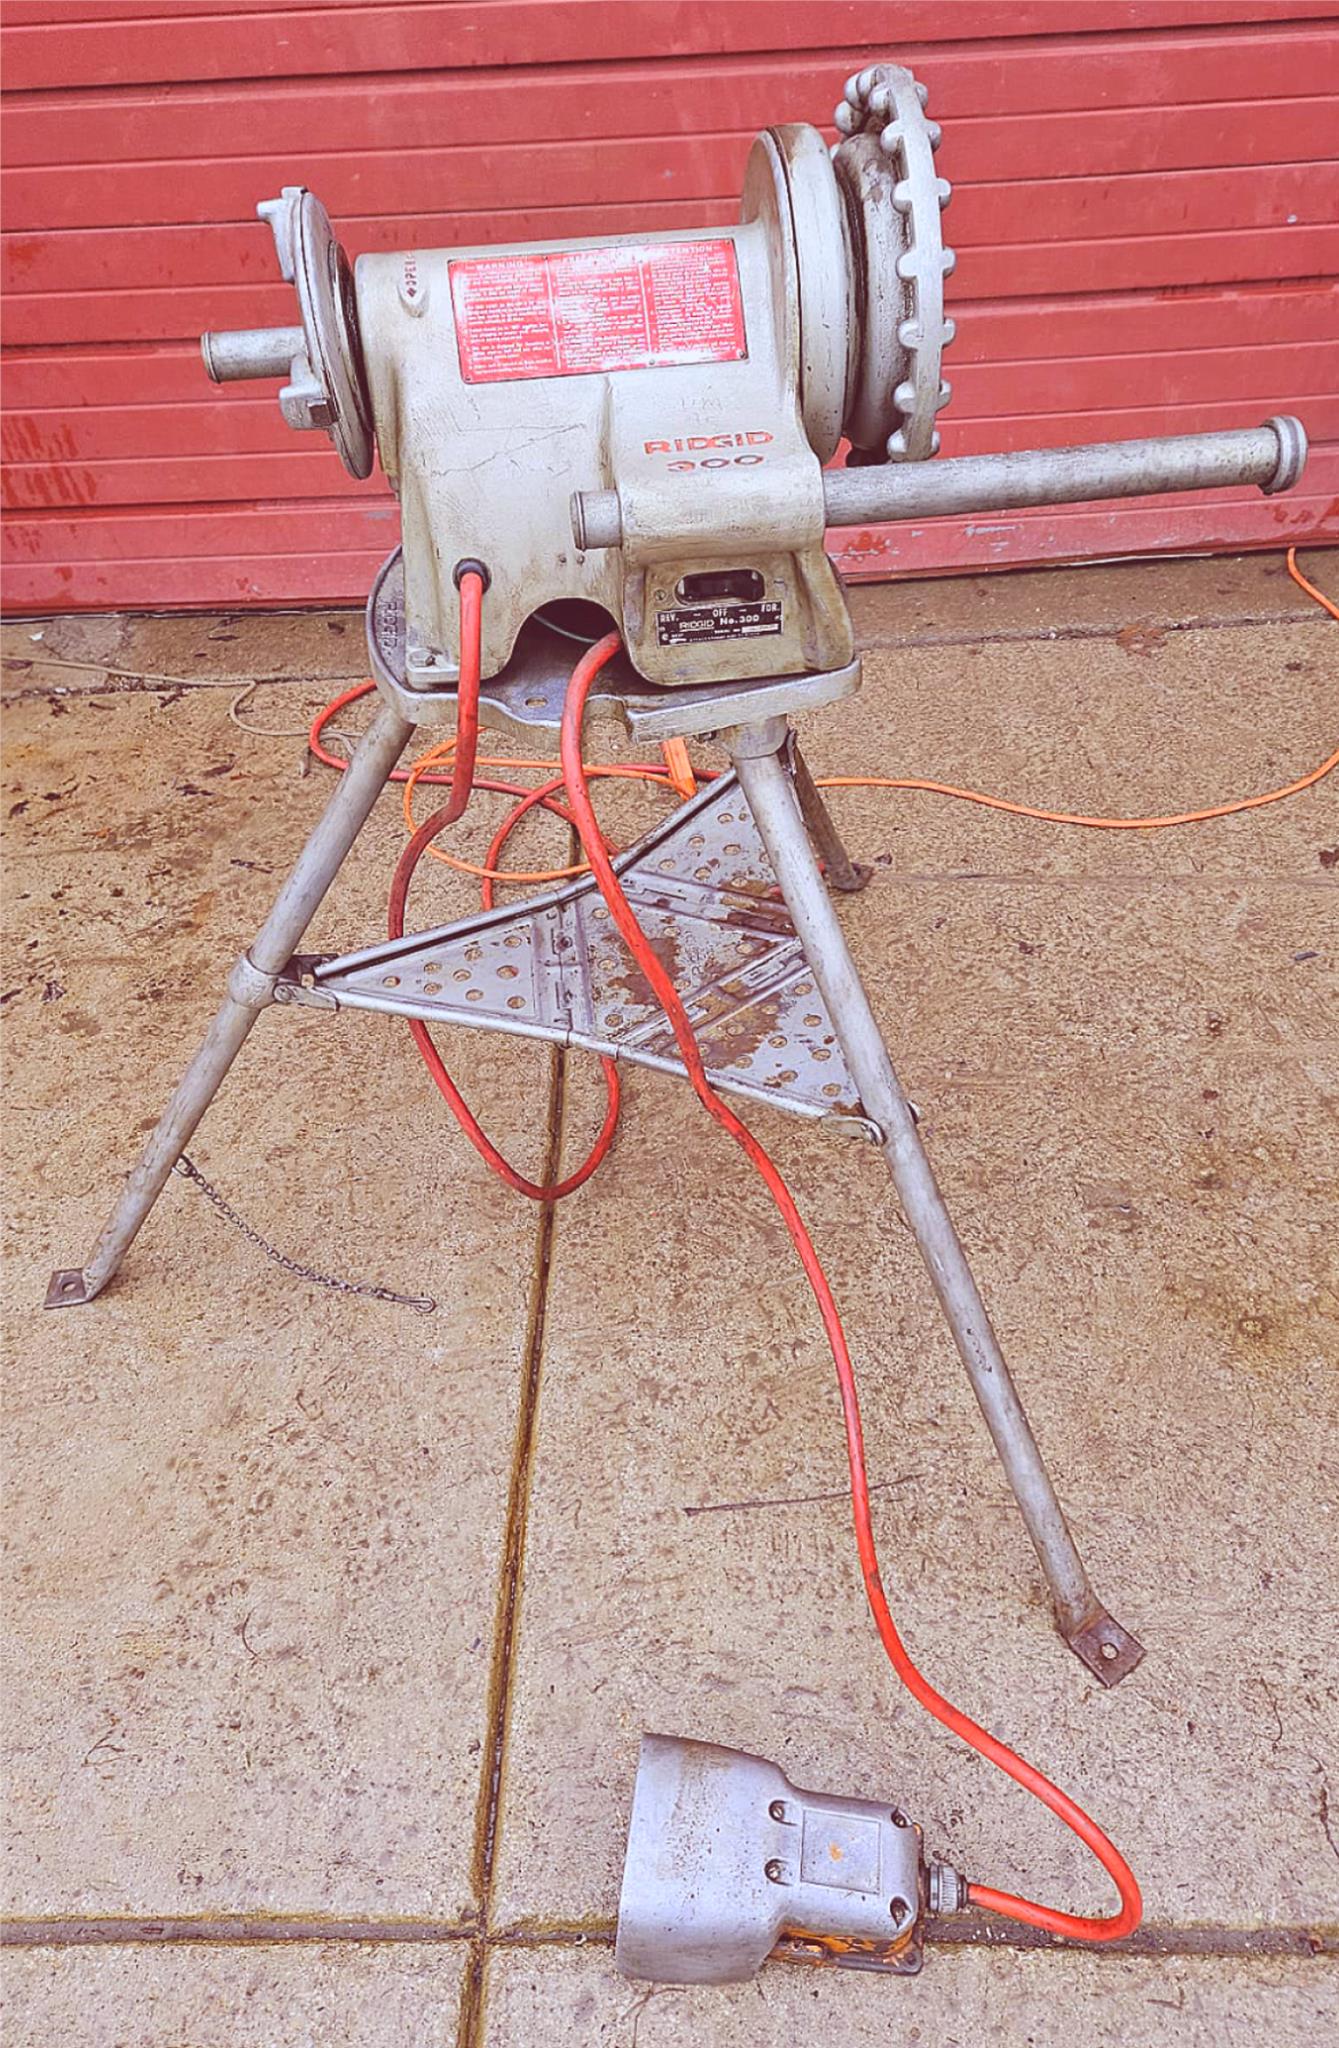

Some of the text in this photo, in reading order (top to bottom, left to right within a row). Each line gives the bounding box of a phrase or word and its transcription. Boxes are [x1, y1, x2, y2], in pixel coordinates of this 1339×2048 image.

[643, 430, 774, 454] RIDGID
[666, 454, 763, 472] 300
[712, 608, 728, 618] OFF
[679, 619, 715, 630] RIDGID
